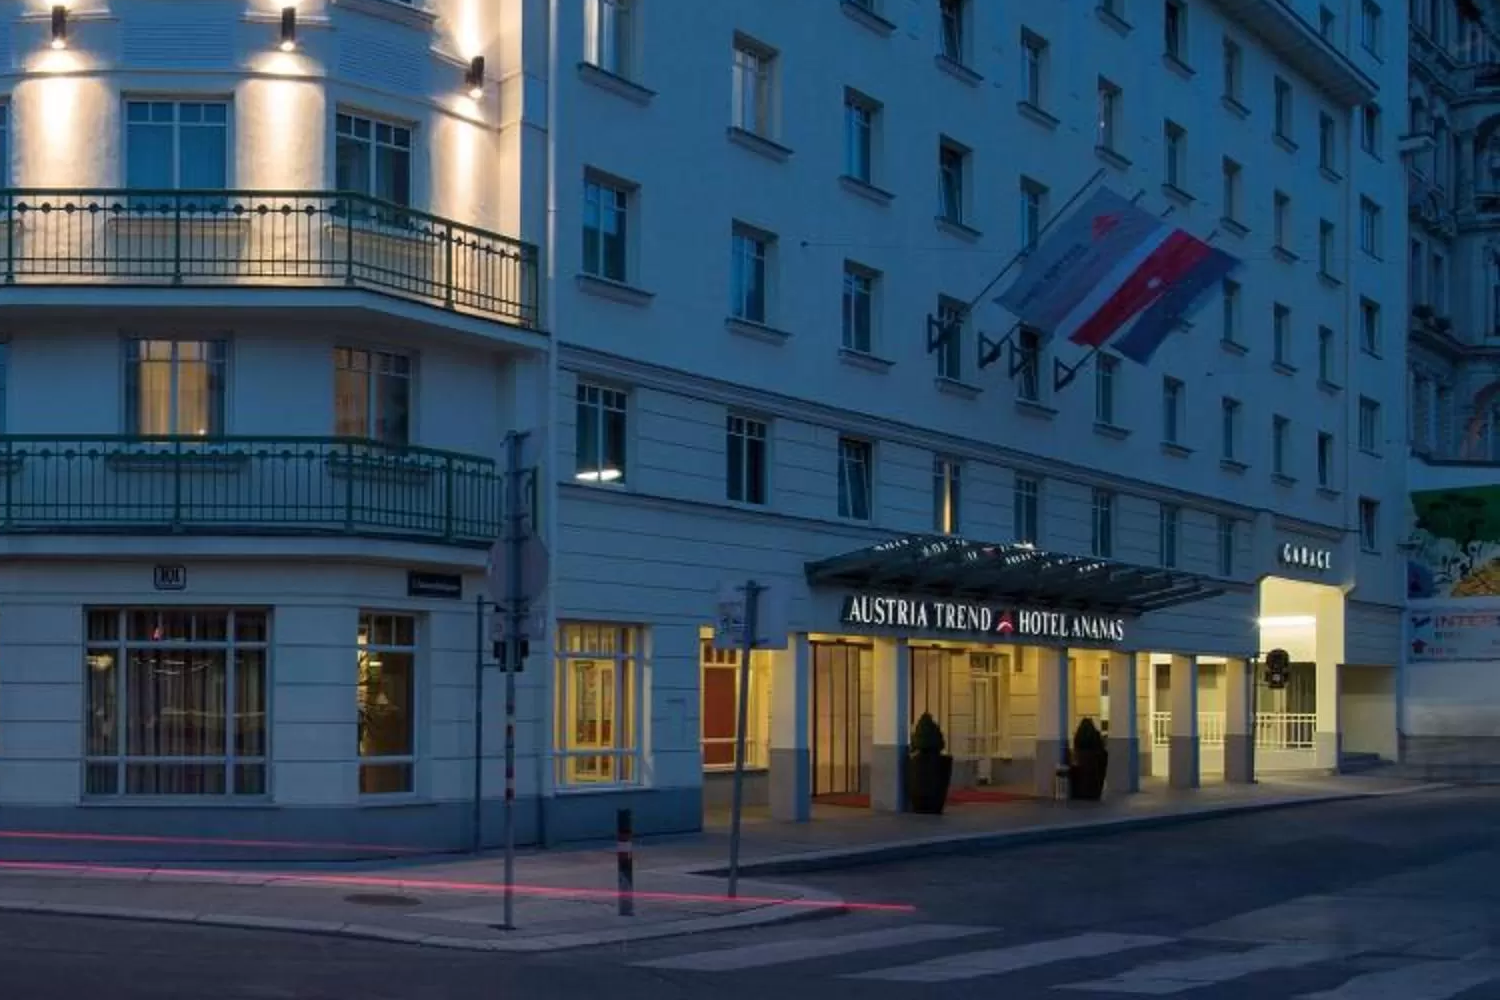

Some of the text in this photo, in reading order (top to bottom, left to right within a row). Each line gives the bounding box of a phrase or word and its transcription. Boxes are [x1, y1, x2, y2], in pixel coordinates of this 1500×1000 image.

[1283, 543, 1331, 568] GARAGE
[849, 595, 1125, 641] AUSTRIA TREND HOTEL ANANAS
